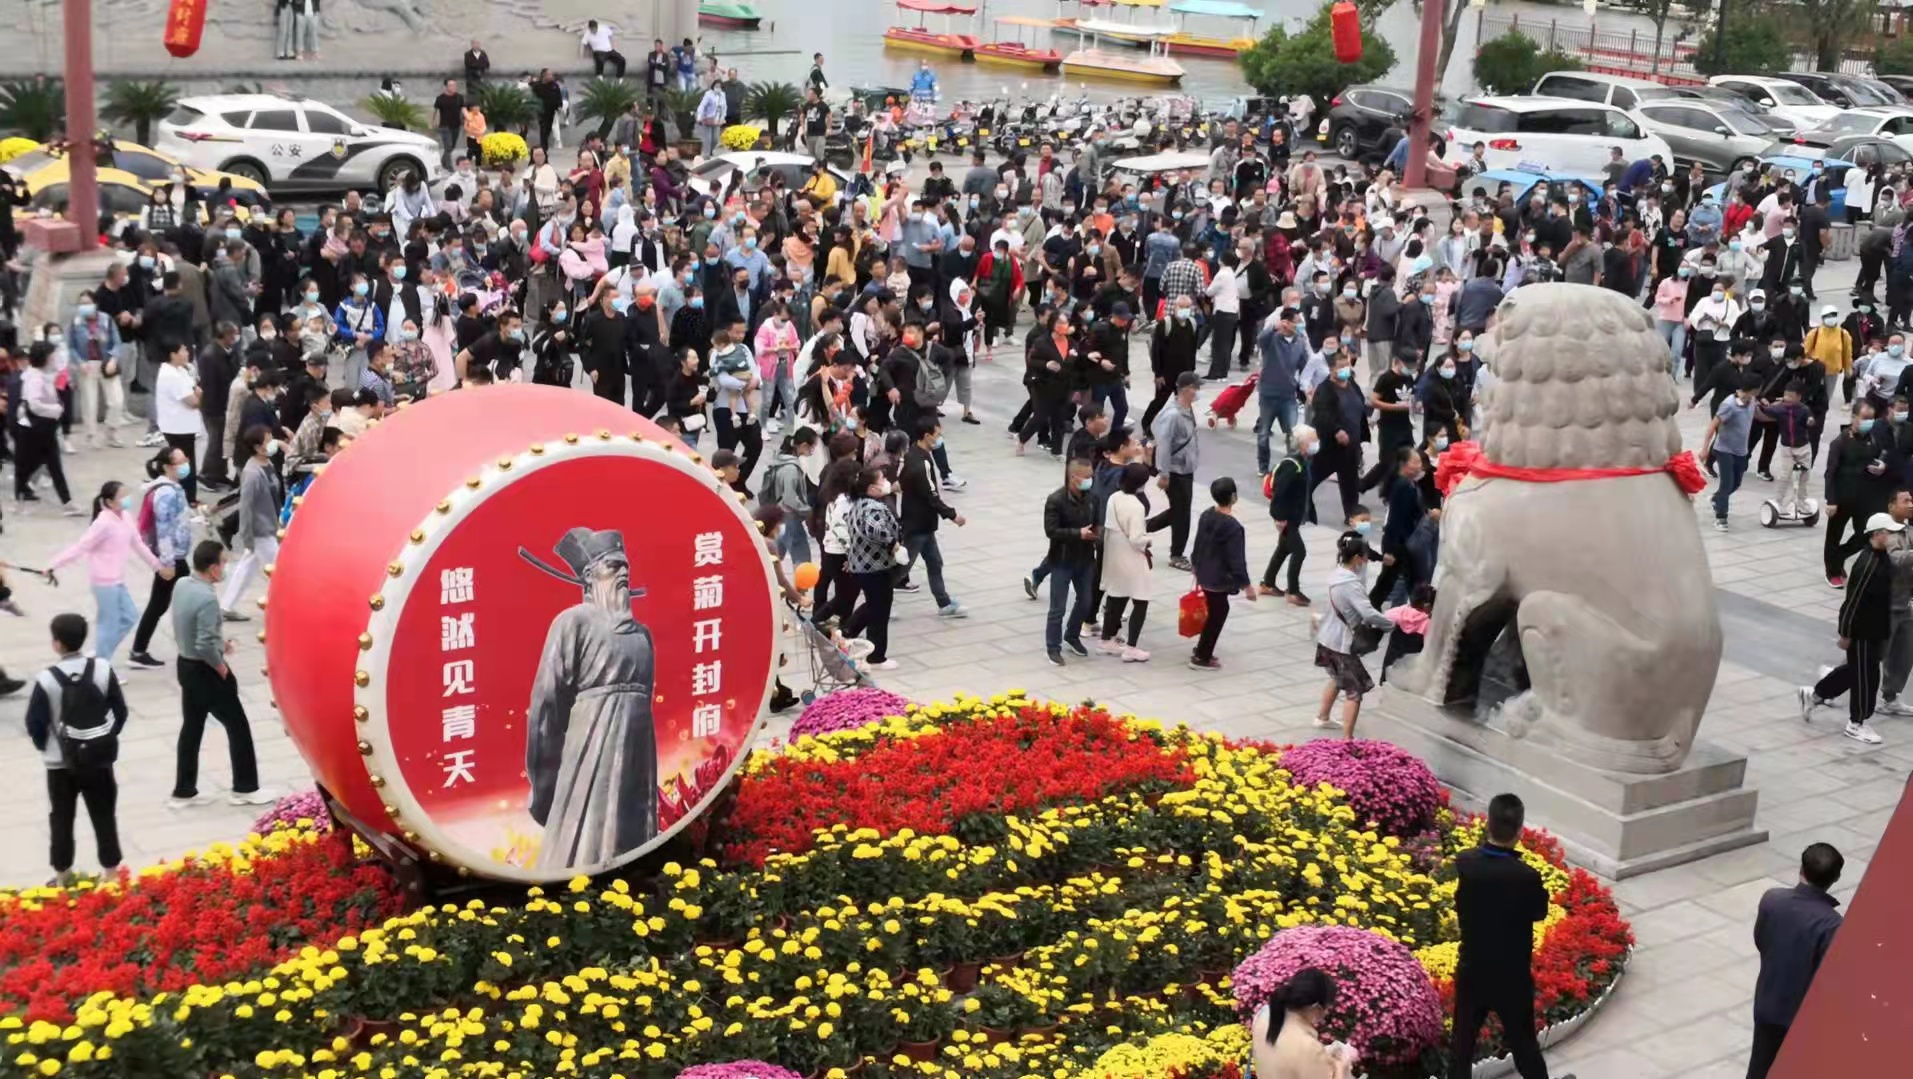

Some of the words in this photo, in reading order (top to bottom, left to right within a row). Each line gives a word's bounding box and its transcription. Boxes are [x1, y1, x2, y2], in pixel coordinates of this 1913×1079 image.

[272, 143, 303, 158] 公安
[440, 567, 476, 788] 悠然见青天
[692, 531, 723, 738] 赏菊开封府
